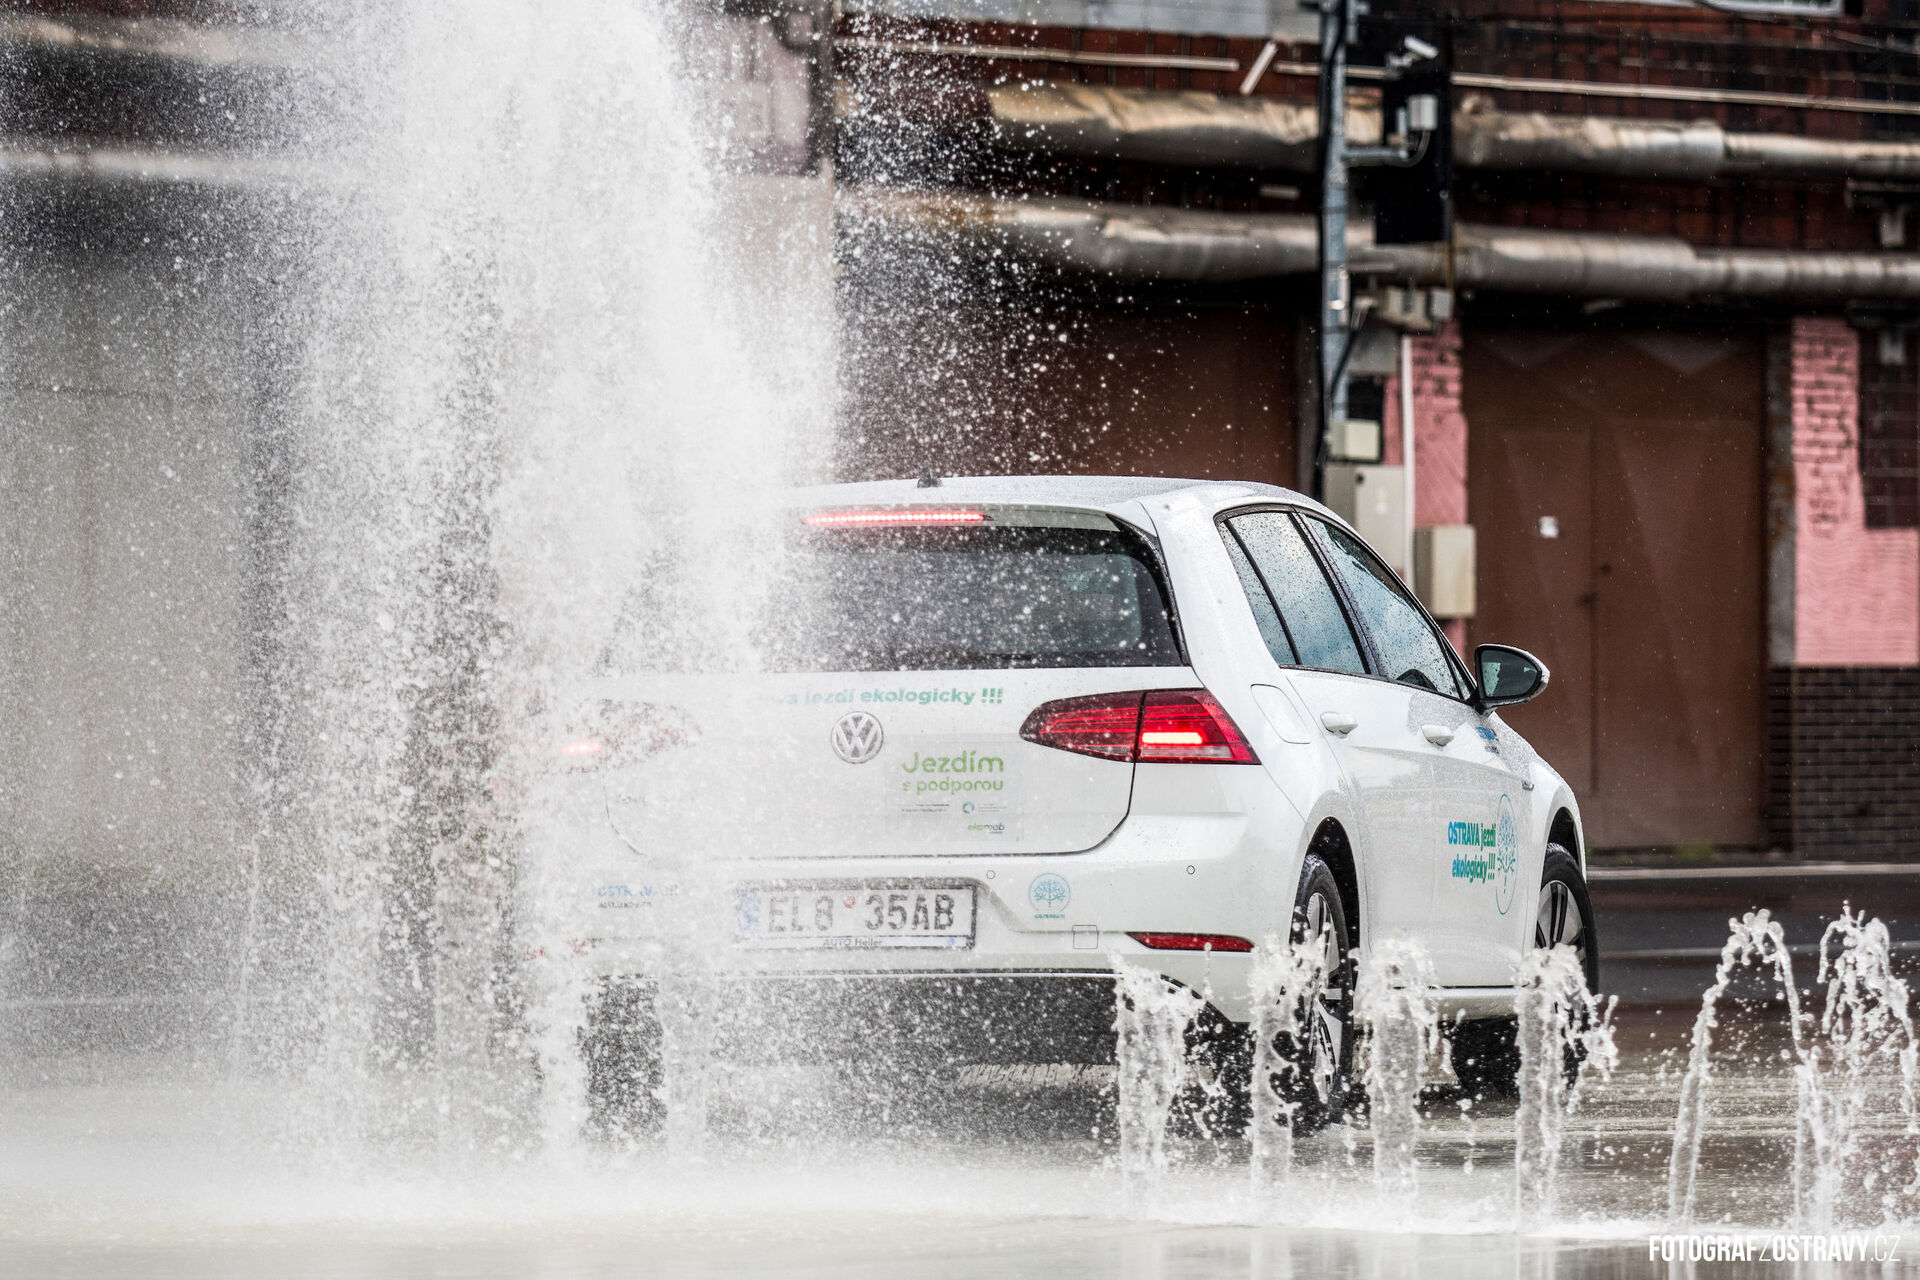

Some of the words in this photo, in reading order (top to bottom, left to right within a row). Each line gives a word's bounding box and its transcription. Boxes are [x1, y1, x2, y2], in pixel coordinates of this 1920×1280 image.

[860, 688, 976, 705] ekologicky
[981, 688, 1004, 704] !!!
[902, 750, 1004, 773] Jezdím
[902, 781, 911, 792] s
[916, 776, 1004, 796] podporou
[1447, 821, 1480, 846] OSTRAVA
[1480, 823, 1496, 851] jezdí
[1451, 853, 1488, 884] ekologicky
[1488, 853, 1496, 880] !!!
[768, 894, 835, 932] EL8
[865, 893, 956, 931] 35AB
